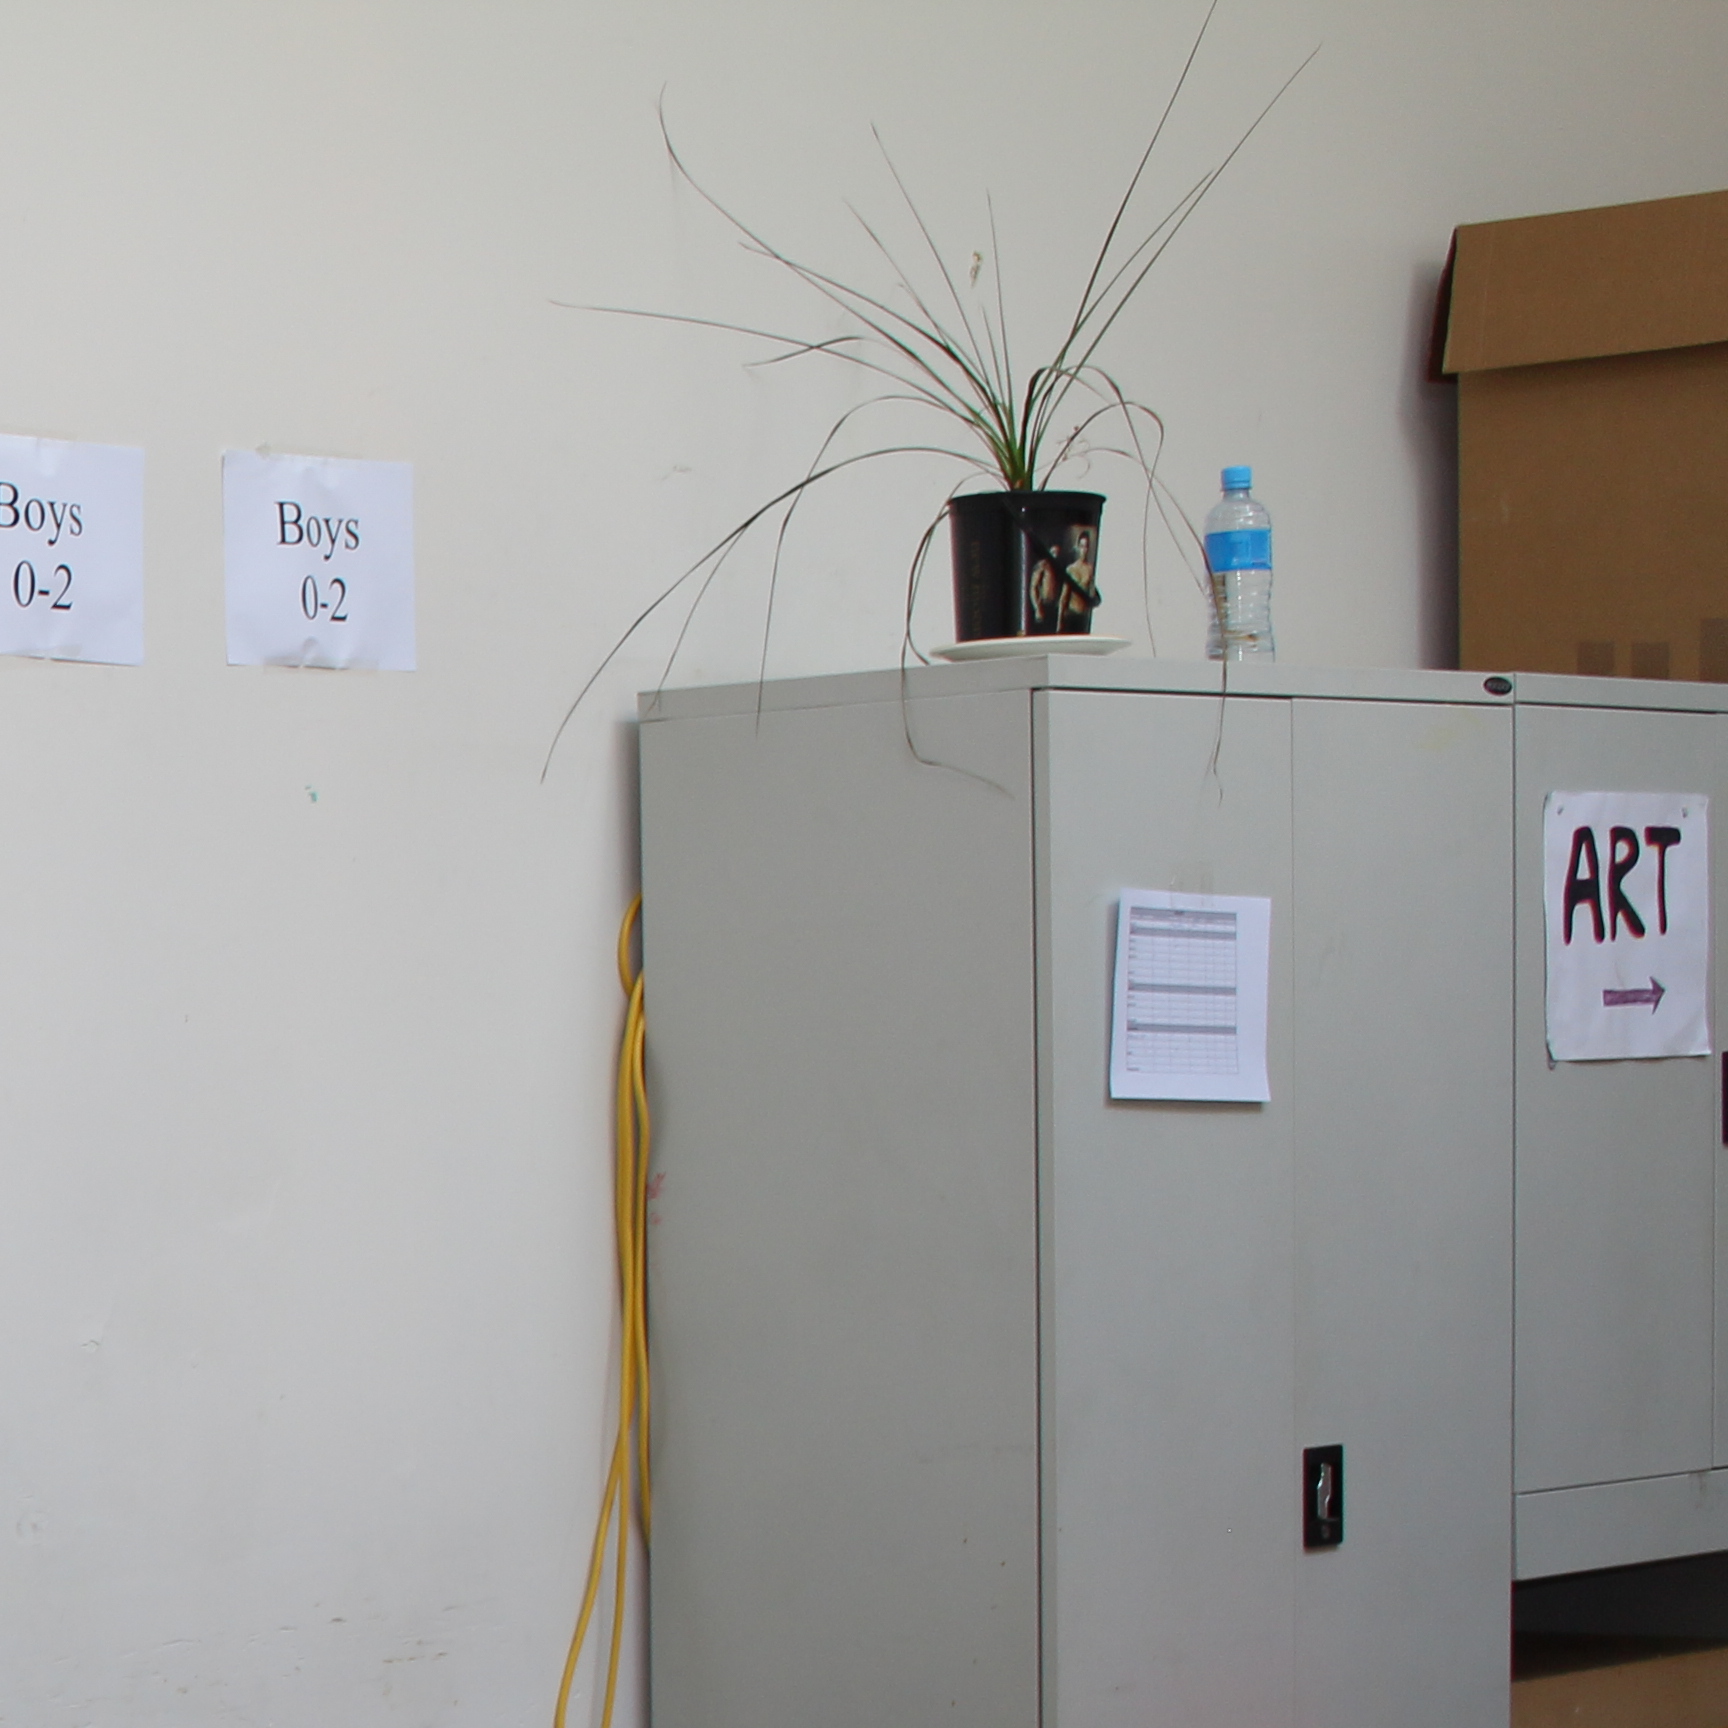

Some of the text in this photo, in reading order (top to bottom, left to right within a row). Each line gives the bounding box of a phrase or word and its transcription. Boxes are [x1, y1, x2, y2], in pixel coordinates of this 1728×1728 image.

[275, 500, 361, 553] Boys
[12, 560, 73, 613] 0-2
[300, 575, 349, 624] 0-2
[1562, 826, 1683, 946] ART
